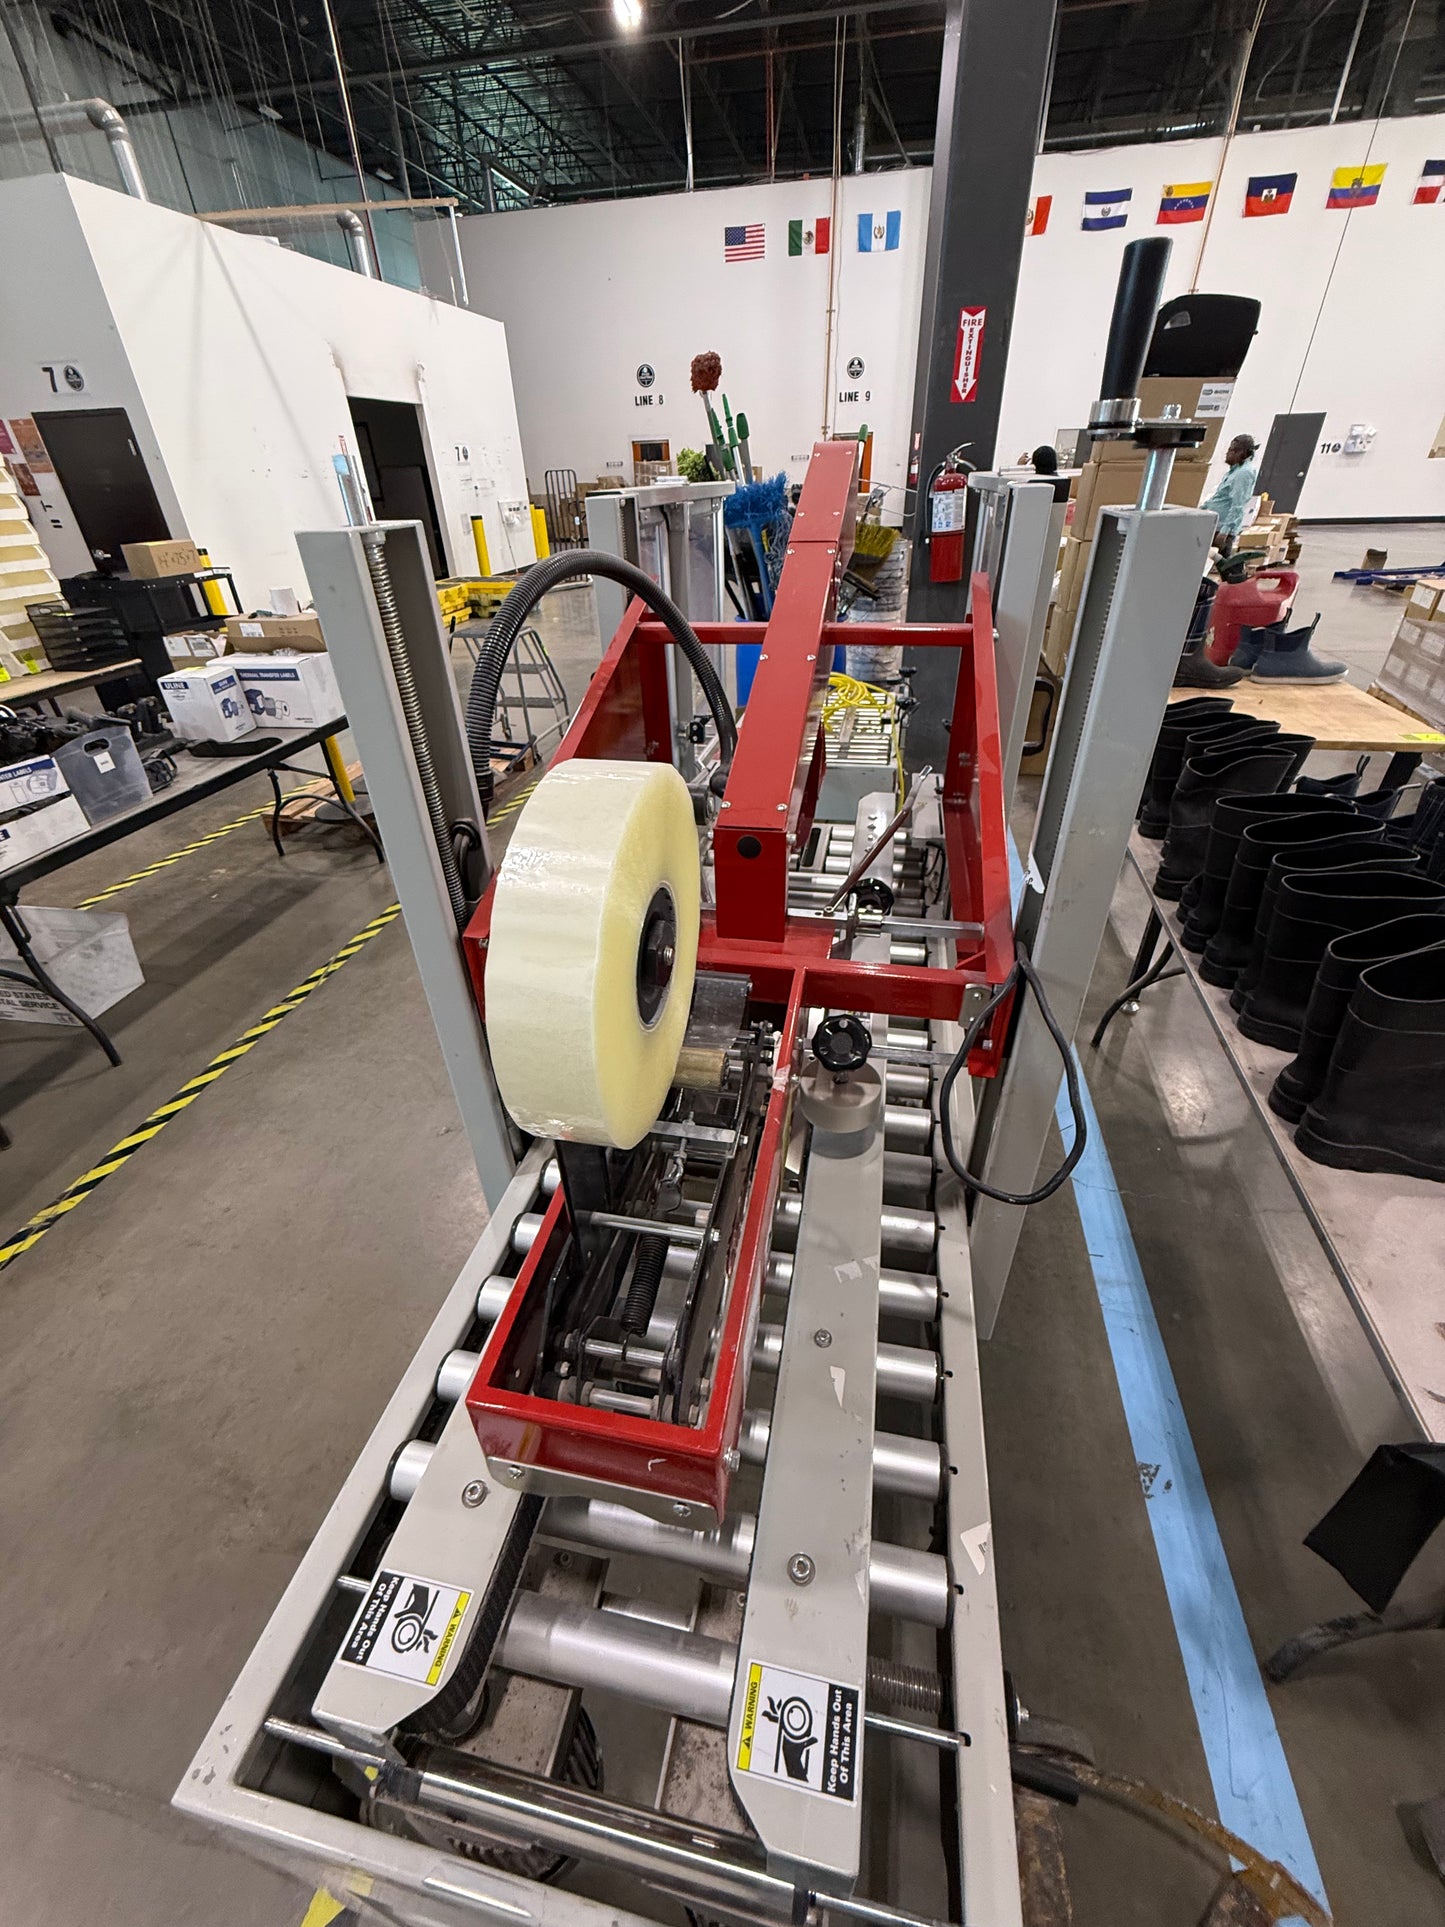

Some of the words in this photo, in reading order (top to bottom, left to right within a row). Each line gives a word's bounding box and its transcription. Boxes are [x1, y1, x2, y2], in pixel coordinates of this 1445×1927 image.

[963, 318, 983, 327] FIRE
[961, 327, 975, 394] EXTINGUISHER
[41, 366, 58, 393] 7
[634, 395, 654, 407] LINE
[658, 394, 664, 405] 8
[839, 391, 860, 403] LINE
[865, 390, 871, 401] 9
[1320, 442, 1332, 454] 11
[163, 682, 186, 690] ULINE
[18, 1000, 61, 1010] SERVICE
[377, 1583, 387, 1597] Of
[382, 1576, 400, 1603] Keep
[365, 1598, 379, 1620] This
[366, 1604, 388, 1637] Hands
[351, 1622, 368, 1649] Area
[435, 1623, 457, 1667] WARNING
[356, 1639, 371, 1662] Out
[744, 1681, 758, 1730] WARNING
[832, 1688, 843, 1711] Out
[842, 1702, 853, 1733] Area
[829, 1718, 842, 1756] Hands
[840, 1736, 851, 1763] This
[827, 1758, 840, 1793] Keep
[839, 1766, 849, 1784] Of
